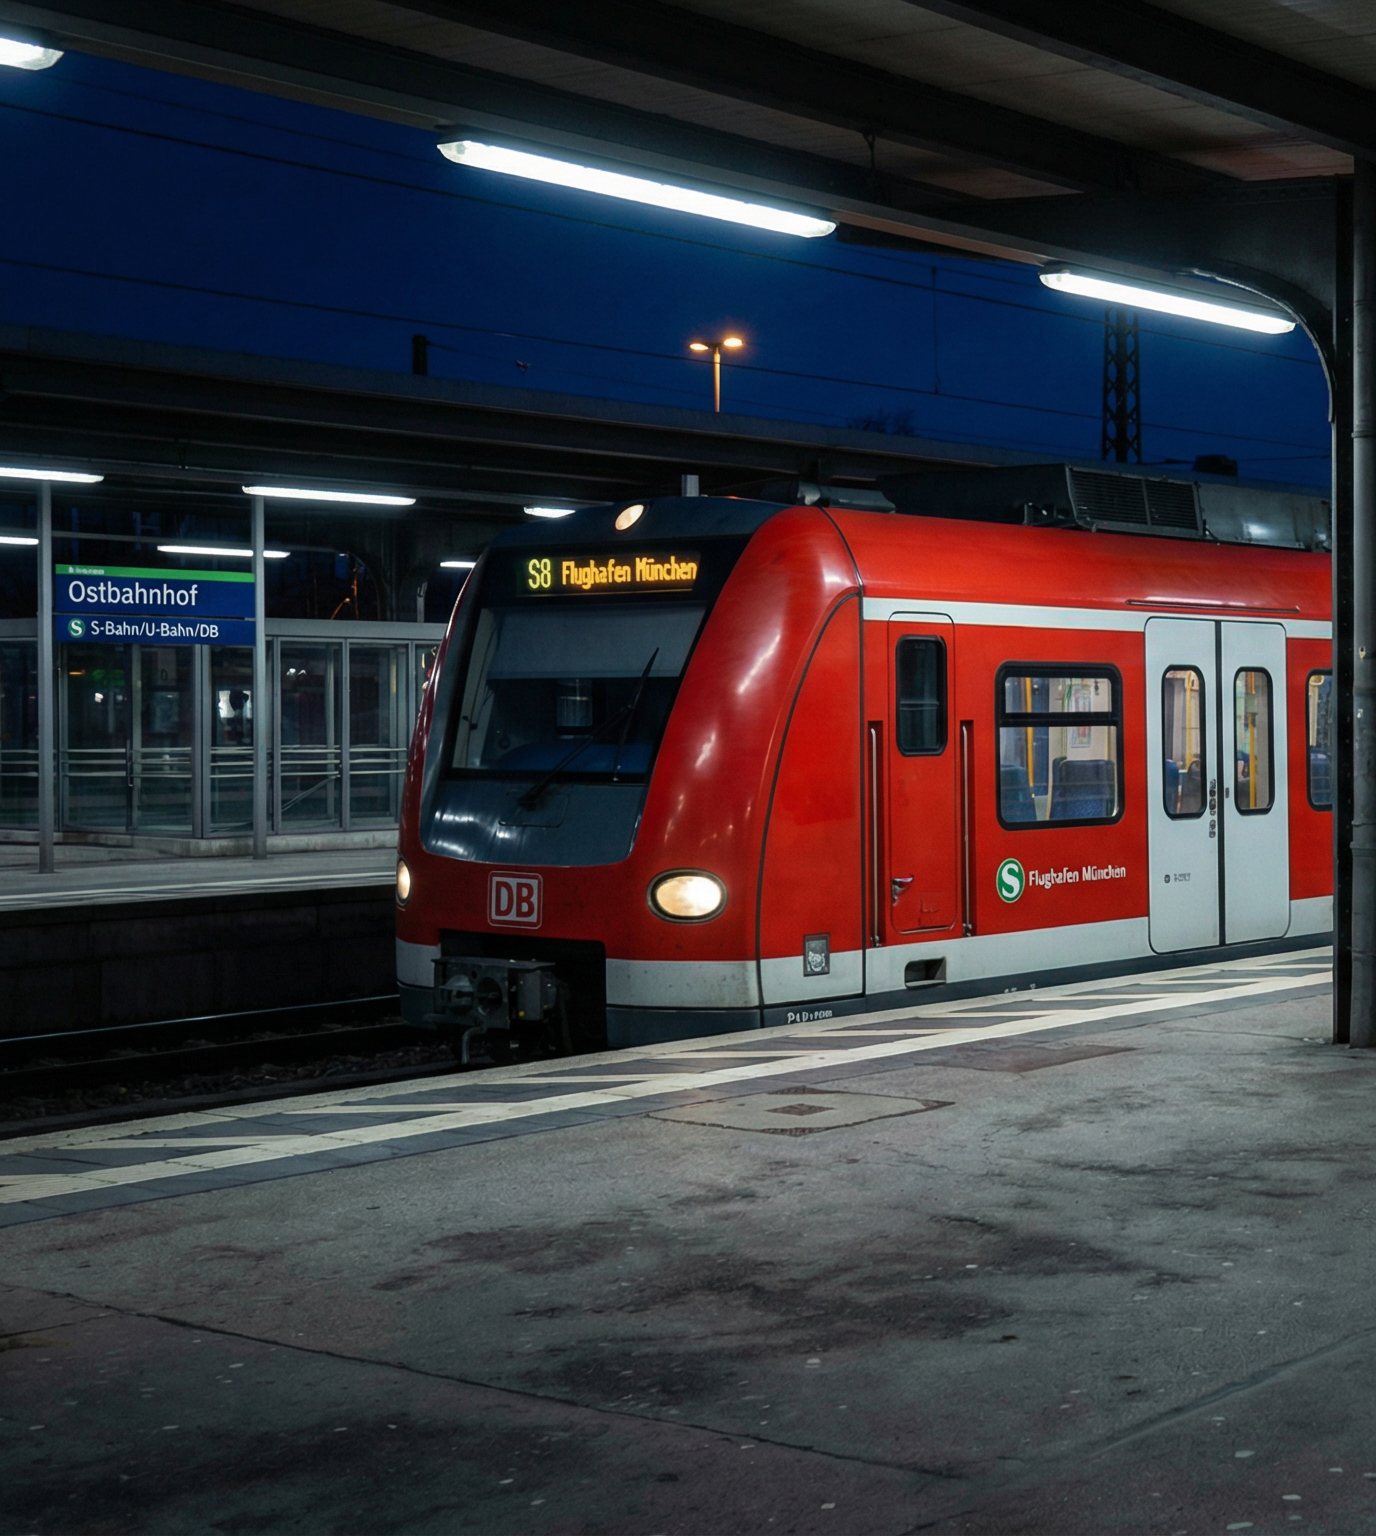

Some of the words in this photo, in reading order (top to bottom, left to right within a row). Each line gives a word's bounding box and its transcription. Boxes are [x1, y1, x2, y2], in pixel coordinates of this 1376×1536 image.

[528, 558, 551, 589] S8
[561, 559, 631, 590] Flughafen
[635, 555, 698, 582] München
[68, 580, 198, 606] Ostbahnhof
[70, 620, 83, 636] S
[90, 620, 220, 638] S-Bahn/U-Bahn/DB
[1001, 863, 1020, 899] S
[495, 880, 535, 918] DB
